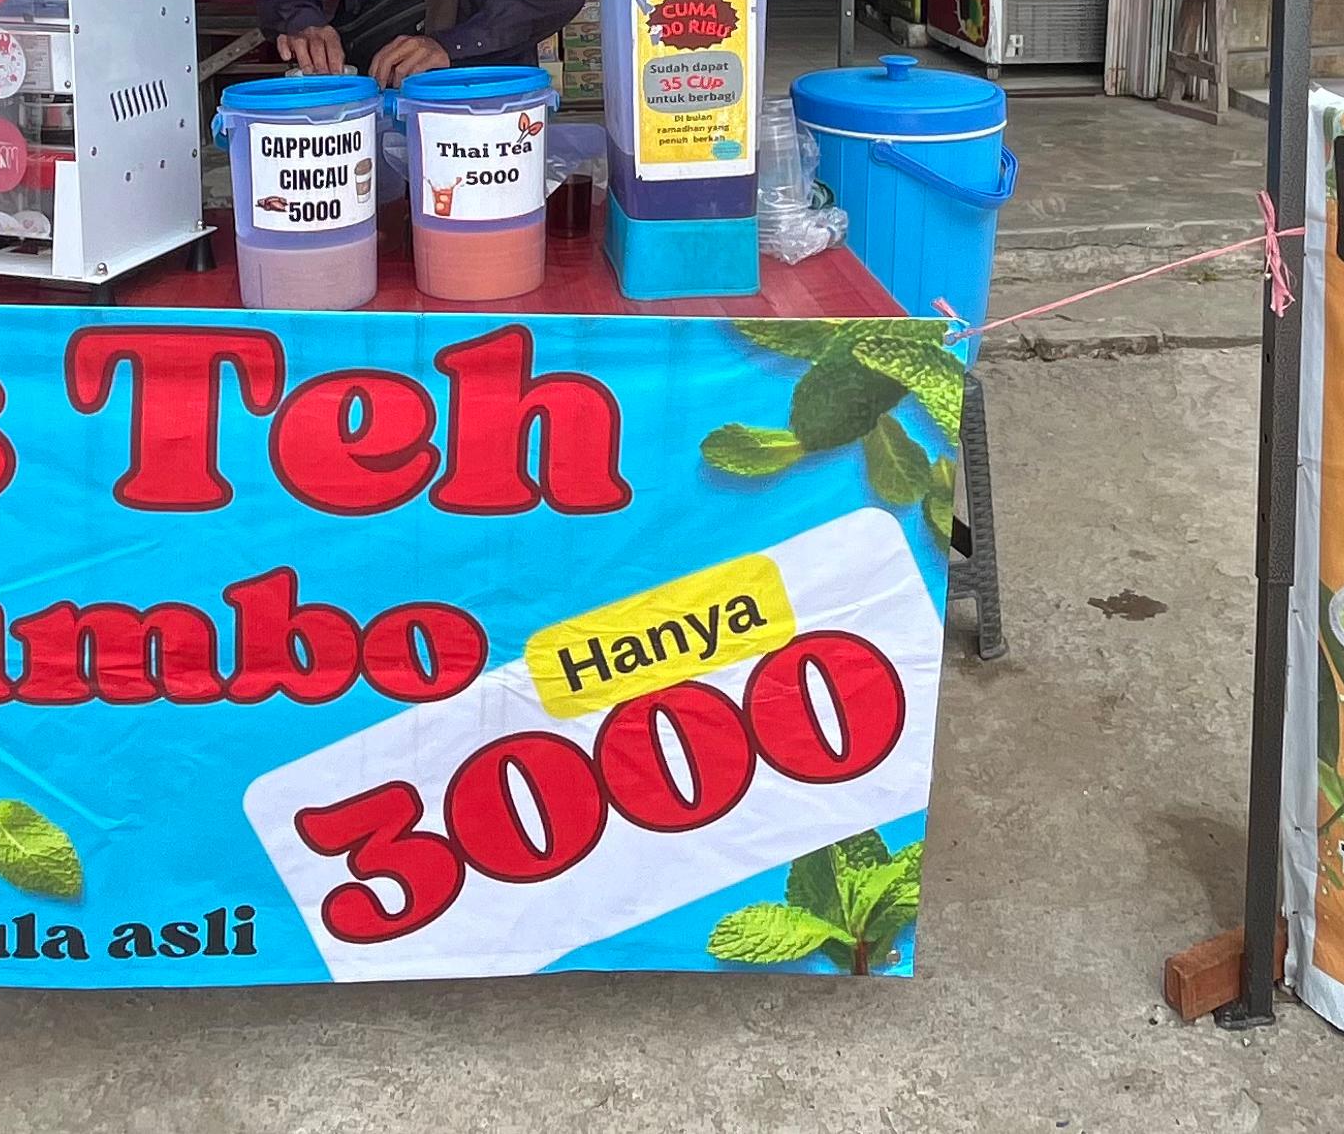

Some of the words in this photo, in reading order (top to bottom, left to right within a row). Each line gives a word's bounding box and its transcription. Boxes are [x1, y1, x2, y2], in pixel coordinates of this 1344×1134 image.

[662, 1, 718, 19] CUMA
[688, 19, 732, 38] RIBU
[650, 63, 689, 74] Sudah
[692, 62, 729, 73] dapat
[659, 76, 683, 92] 35
[647, 93, 685, 104] untuk
[688, 91, 736, 103] berbagi
[686, 113, 713, 122] bulan
[261, 130, 362, 159] CAPPUCINO
[436, 142, 490, 159] Thai
[496, 141, 533, 157] Tea
[279, 165, 349, 191] CINCAU
[466, 168, 520, 186] 5000
[288, 199, 342, 223] 5000
[63, 322, 634, 517] Teh
[557, 587, 767, 694] Hanya
[293, 629, 907, 945] 3000
[106, 904, 258, 960] asli
